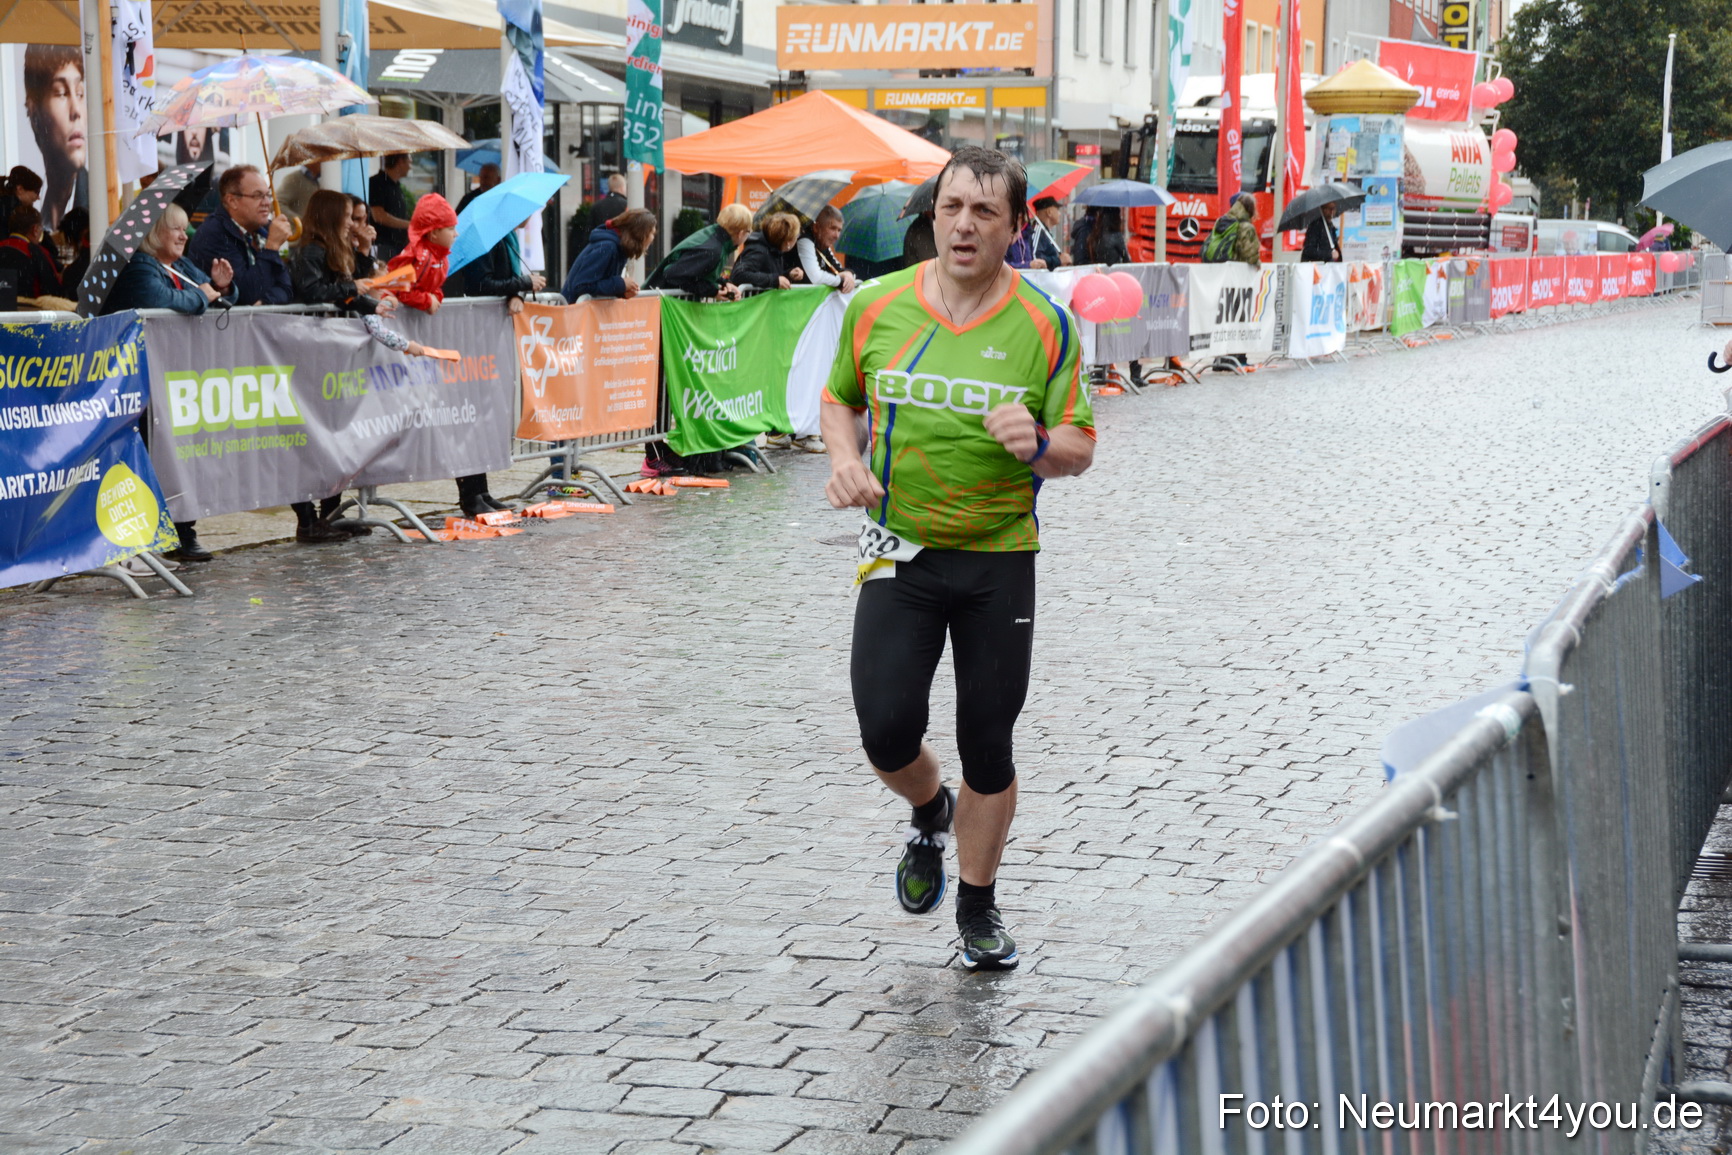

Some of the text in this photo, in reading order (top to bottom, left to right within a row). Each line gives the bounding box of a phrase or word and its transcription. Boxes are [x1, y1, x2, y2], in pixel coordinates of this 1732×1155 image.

[885, 92, 977, 106] RUNMARKT.DE
[0, 342, 139, 390] SUCHEN DICH!
[440, 355, 500, 385] LOUNGE
[165, 368, 302, 432] BOCK
[175, 438, 208, 462] nspired
[211, 437, 224, 459] by
[108, 498, 136, 523] DICH
